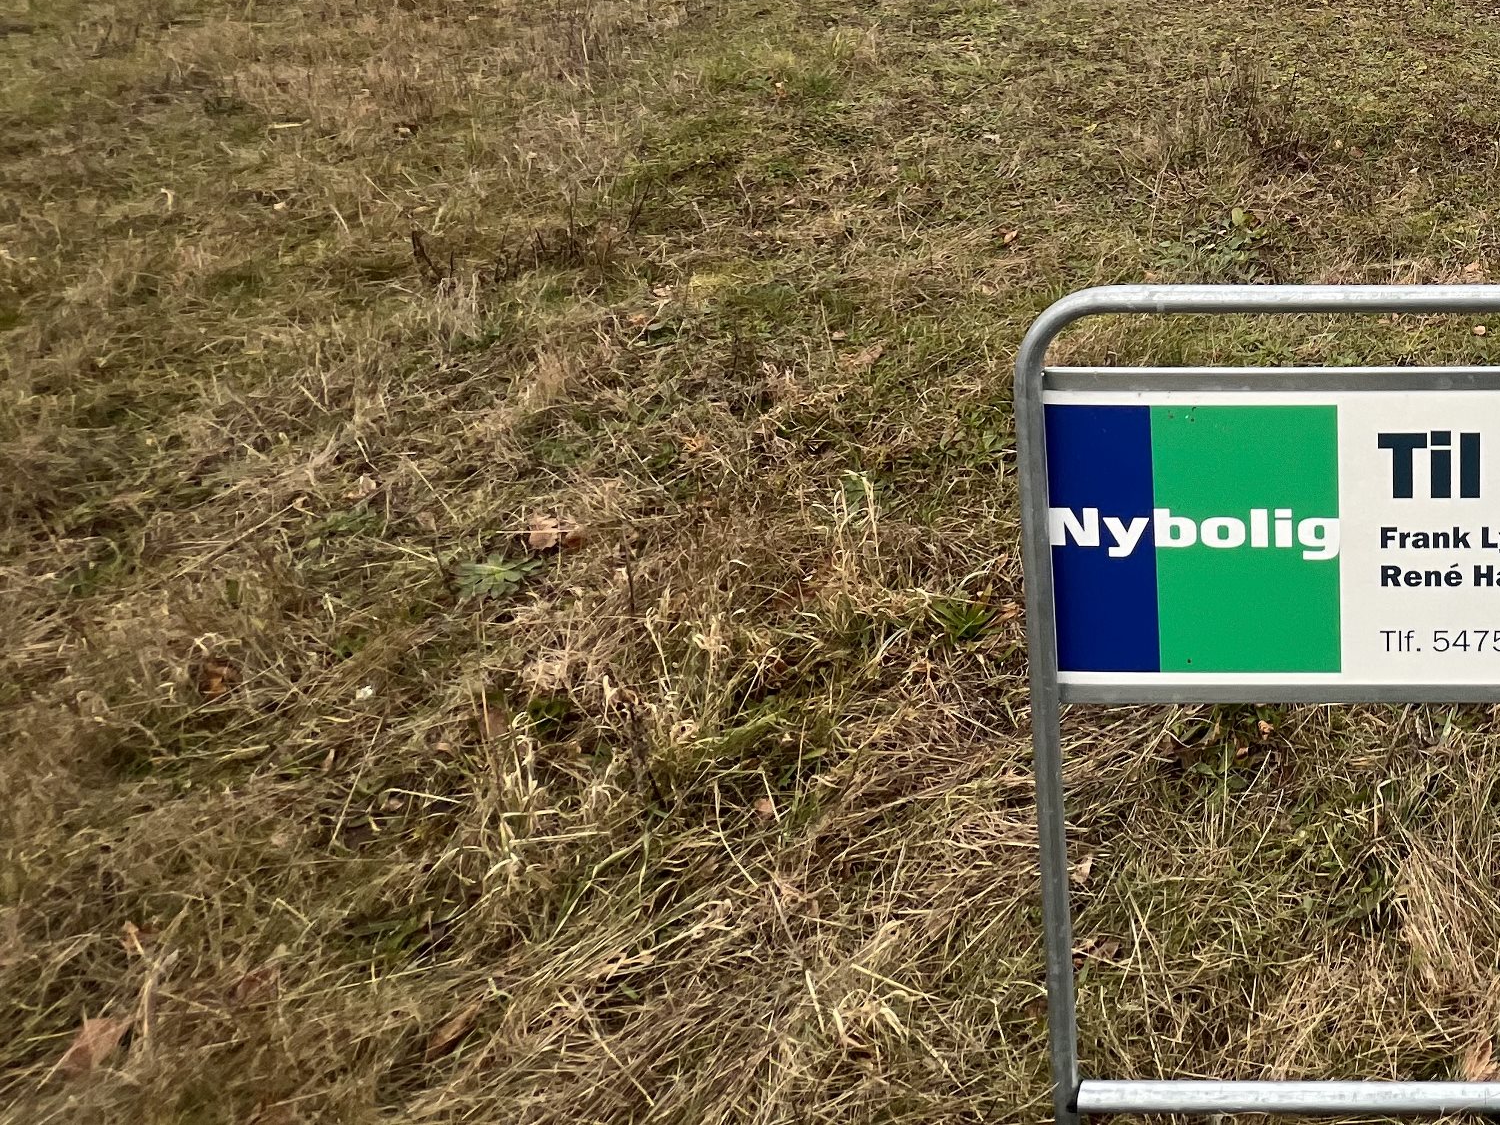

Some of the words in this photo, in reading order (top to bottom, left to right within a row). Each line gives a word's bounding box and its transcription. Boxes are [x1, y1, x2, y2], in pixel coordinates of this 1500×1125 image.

[1377, 430, 1481, 499] Til
[1048, 507, 1340, 560] Nybolig
[1380, 526, 1472, 549] Frank
[1380, 562, 1463, 588] René
[1379, 629, 1421, 653] Tlf.
